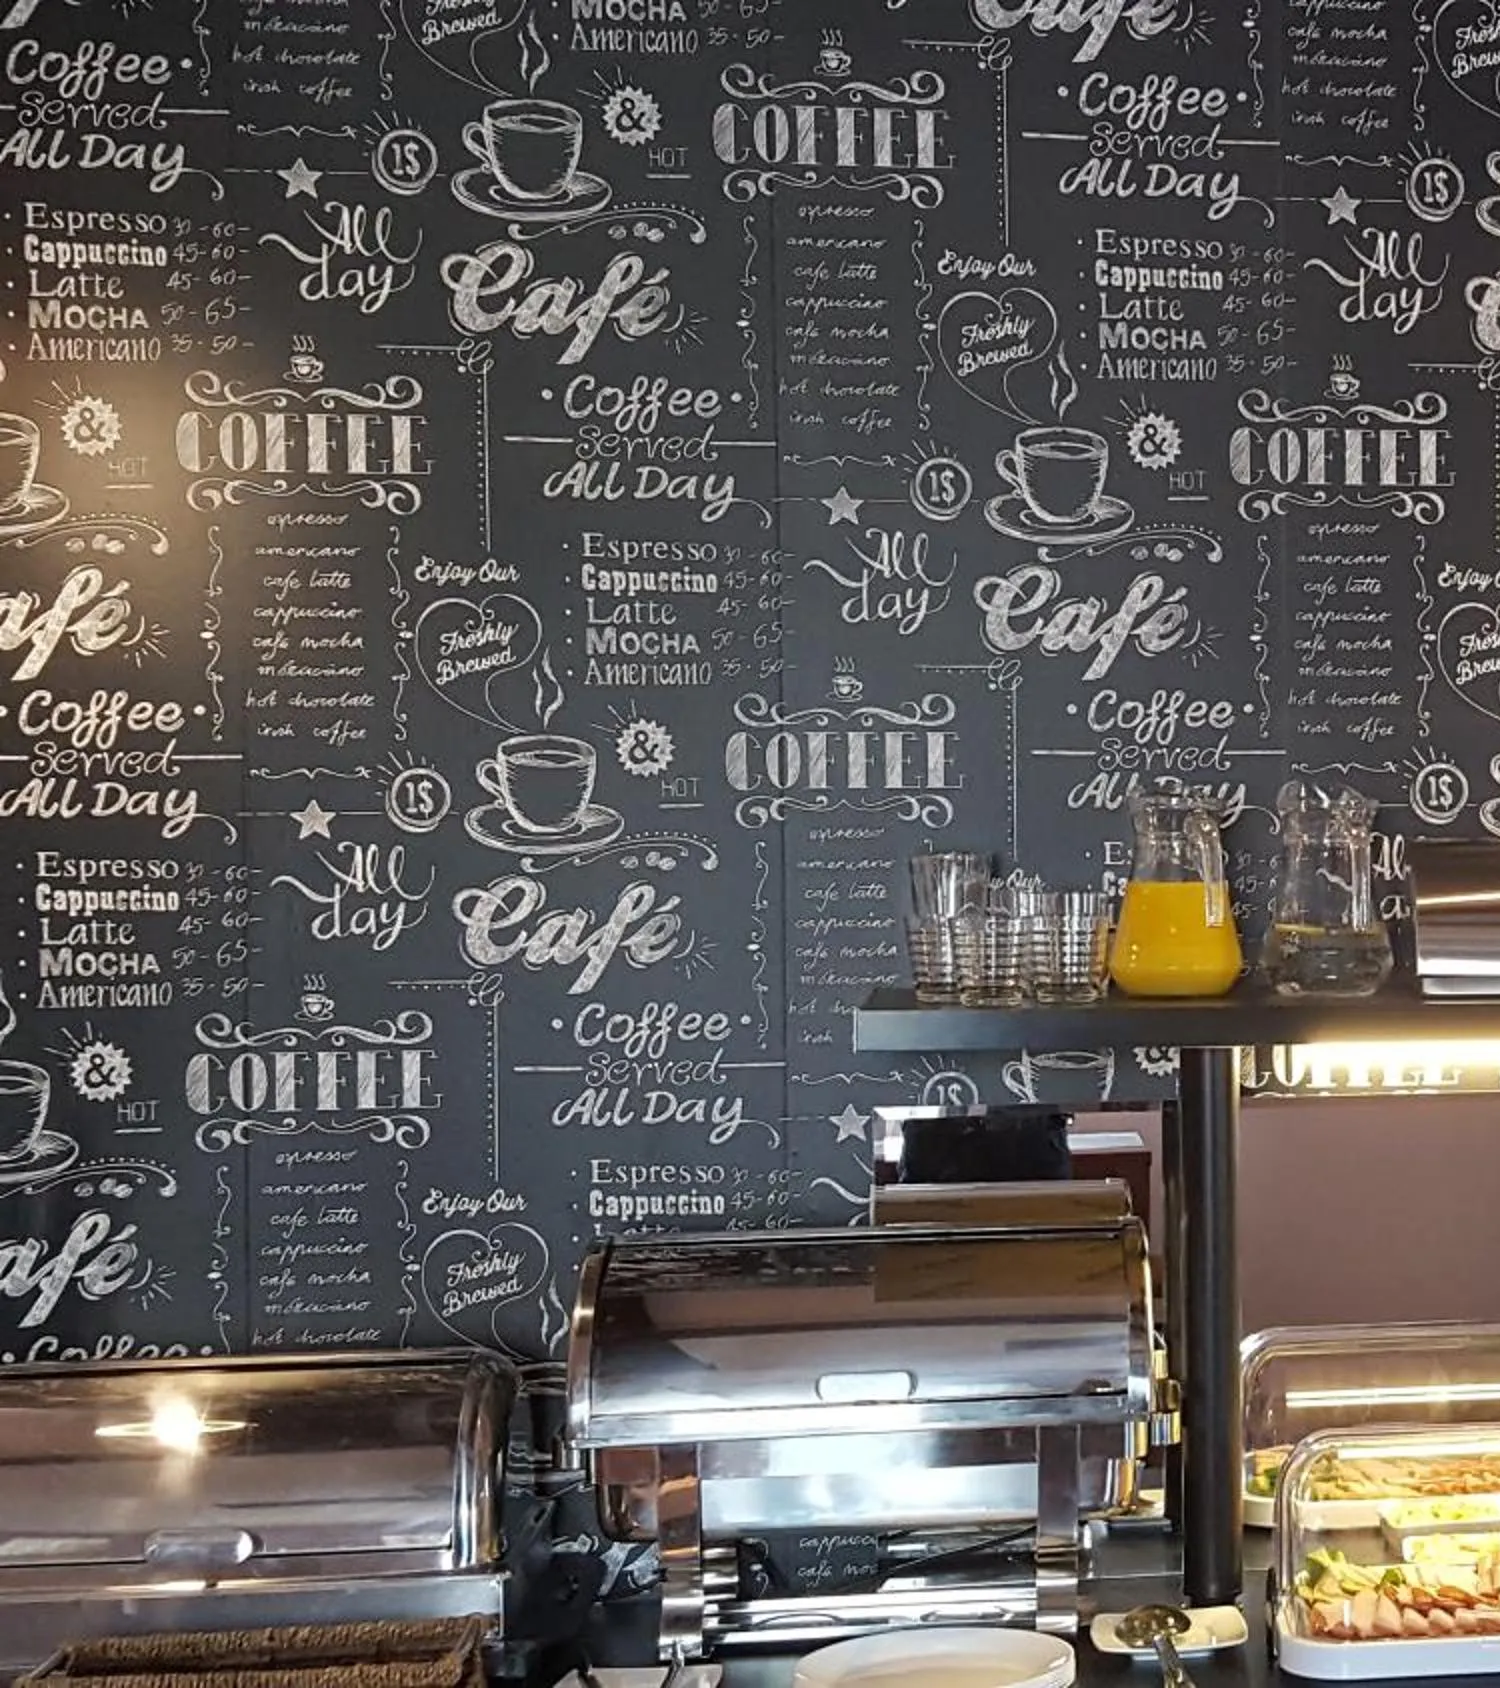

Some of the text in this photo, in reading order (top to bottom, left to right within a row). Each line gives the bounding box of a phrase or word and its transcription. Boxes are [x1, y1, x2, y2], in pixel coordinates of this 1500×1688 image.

[1330, 27, 1387, 40] mocha
[6, 40, 172, 99] Coffee
[15, 91, 167, 130] Served
[1079, 72, 1228, 131] Coffee
[713, 104, 956, 169] COFFEE
[1089, 123, 1224, 159] Served
[0, 129, 188, 193] All Day
[1060, 158, 1240, 220] All Day
[23, 202, 167, 235] Espresso
[305, 202, 422, 262] All
[23, 236, 167, 268] Cappuccino
[1096, 230, 1224, 259] Espresso
[29, 269, 124, 299] Latte
[299, 244, 396, 313] day
[937, 251, 1036, 284] Enjoy Our
[1095, 260, 1223, 292] Cappuccino
[440, 239, 670, 364] Café
[1099, 293, 1184, 321] Latte
[27, 333, 161, 361] Americano
[830, 324, 890, 338] mocha
[961, 316, 1034, 348] Freshly
[958, 341, 1033, 376] Brewed
[1097, 352, 1217, 381] Americano
[562, 373, 721, 433] Coffee
[176, 411, 436, 475] COFFEE
[576, 425, 719, 462] Served
[1230, 427, 1456, 486] COFFEE
[544, 460, 734, 522] All Day
[581, 533, 717, 564] Espresso
[846, 528, 956, 586] All
[415, 556, 520, 588] Enjoy Our
[581, 564, 717, 596] Cappuccino
[1437, 561, 1492, 590] Enjoy
[588, 598, 677, 625] Latte
[841, 570, 929, 635] day
[440, 622, 520, 656] Freshly
[973, 563, 1189, 681] Café
[300, 635, 364, 649] mocha
[436, 650, 517, 685] Brewed
[584, 658, 712, 685] Americano
[19, 690, 184, 750] Coffee
[313, 719, 366, 745] coffee
[30, 739, 180, 778] Served
[725, 731, 963, 792] COFFEE
[1, 777, 200, 839] All Day
[36, 852, 180, 882] Espresso
[316, 842, 435, 901] All
[36, 882, 180, 914] Cappuccino
[41, 917, 136, 946] Latte
[312, 886, 408, 951] day
[452, 875, 682, 995] Café
[37, 980, 173, 1009] Americano
[574, 1002, 732, 1058] Coffee
[186, 1049, 443, 1113] COFFEE
[586, 1041, 726, 1087] Served
[117, 1102, 156, 1120] HOT
[552, 1090, 744, 1145] All Day
[590, 1160, 725, 1186] Espresso
[423, 1189, 527, 1220] Enjoy Our
[589, 1189, 725, 1220] Cappuccino
[0, 1210, 137, 1328] afé
[446, 1253, 524, 1288] Freshly
[443, 1278, 522, 1316] Brewed
